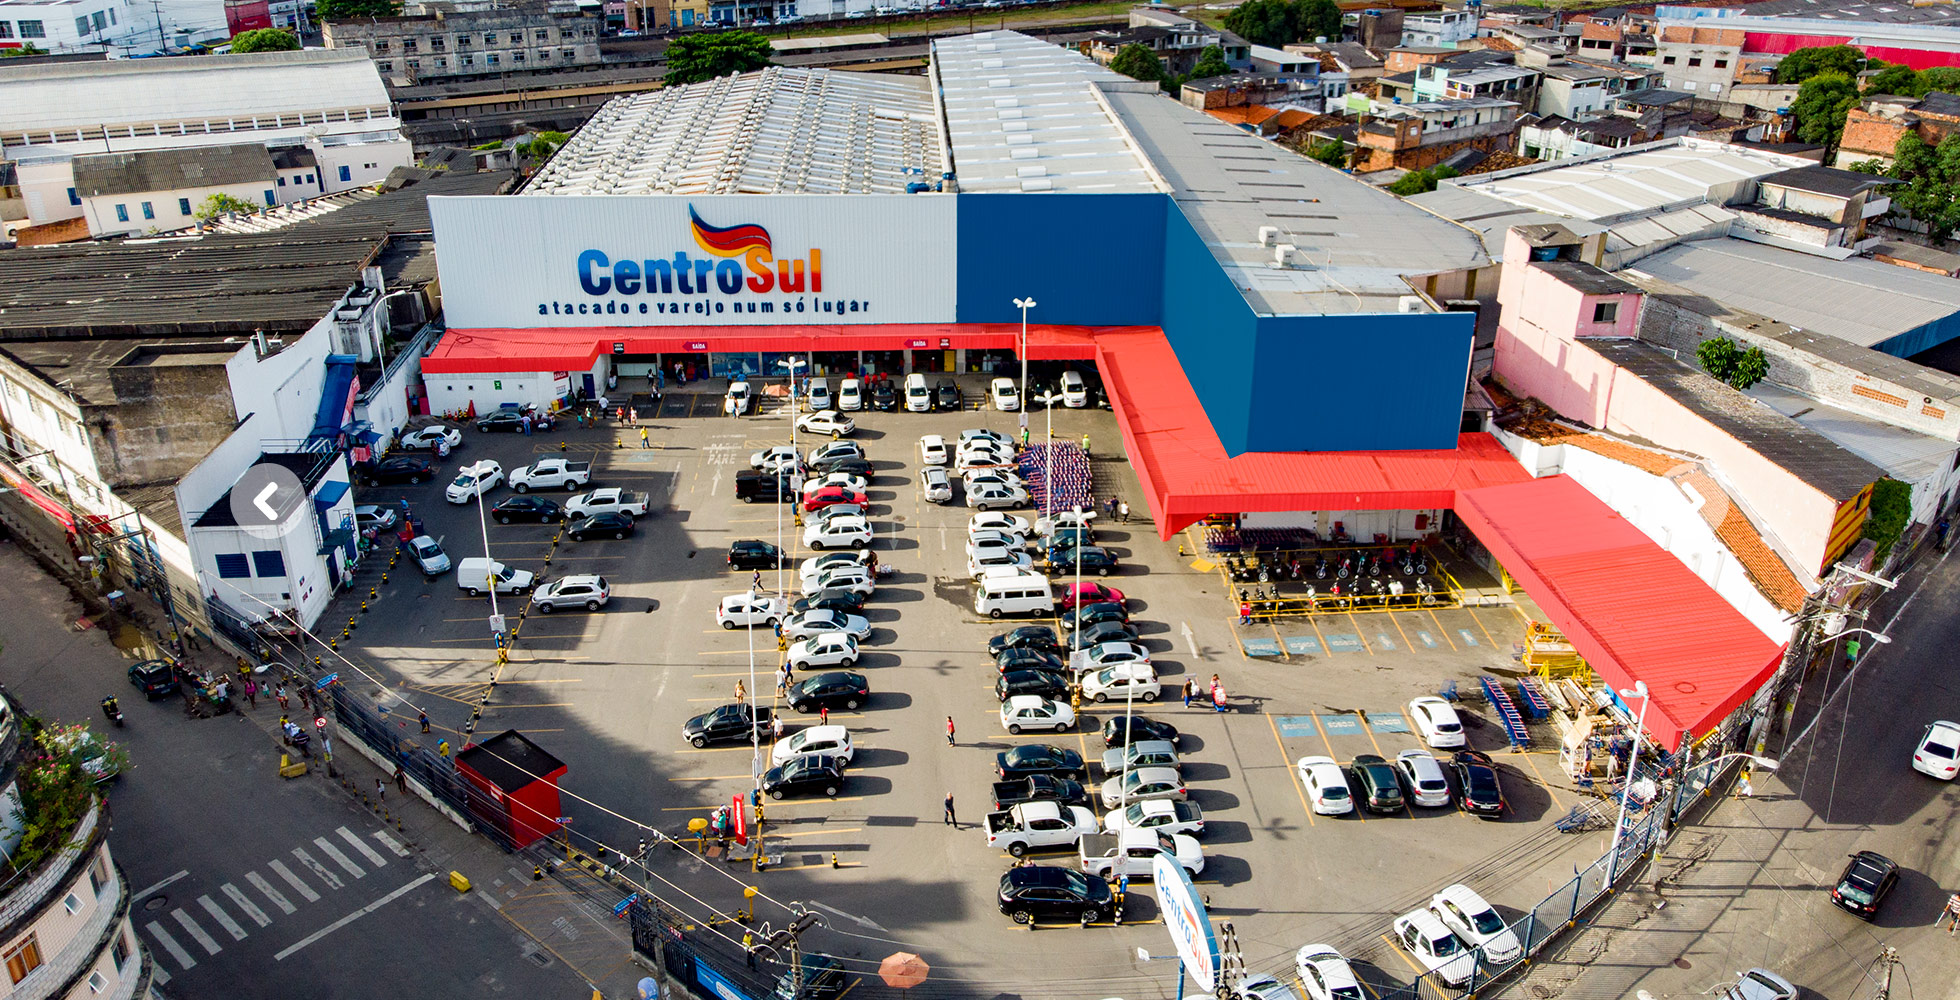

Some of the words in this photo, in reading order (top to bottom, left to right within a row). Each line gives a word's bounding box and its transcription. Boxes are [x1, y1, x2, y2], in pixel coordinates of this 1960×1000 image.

[577, 248, 822, 296] CentroSul
[538, 300, 629, 315] atacado
[639, 302, 648, 314] e
[657, 299, 724, 316] varejo
[734, 302, 774, 313] num
[783, 297, 805, 313] só
[814, 298, 869, 315] lugar
[707, 454, 737, 464] PARE
[1159, 868, 1208, 978] CentroSul
